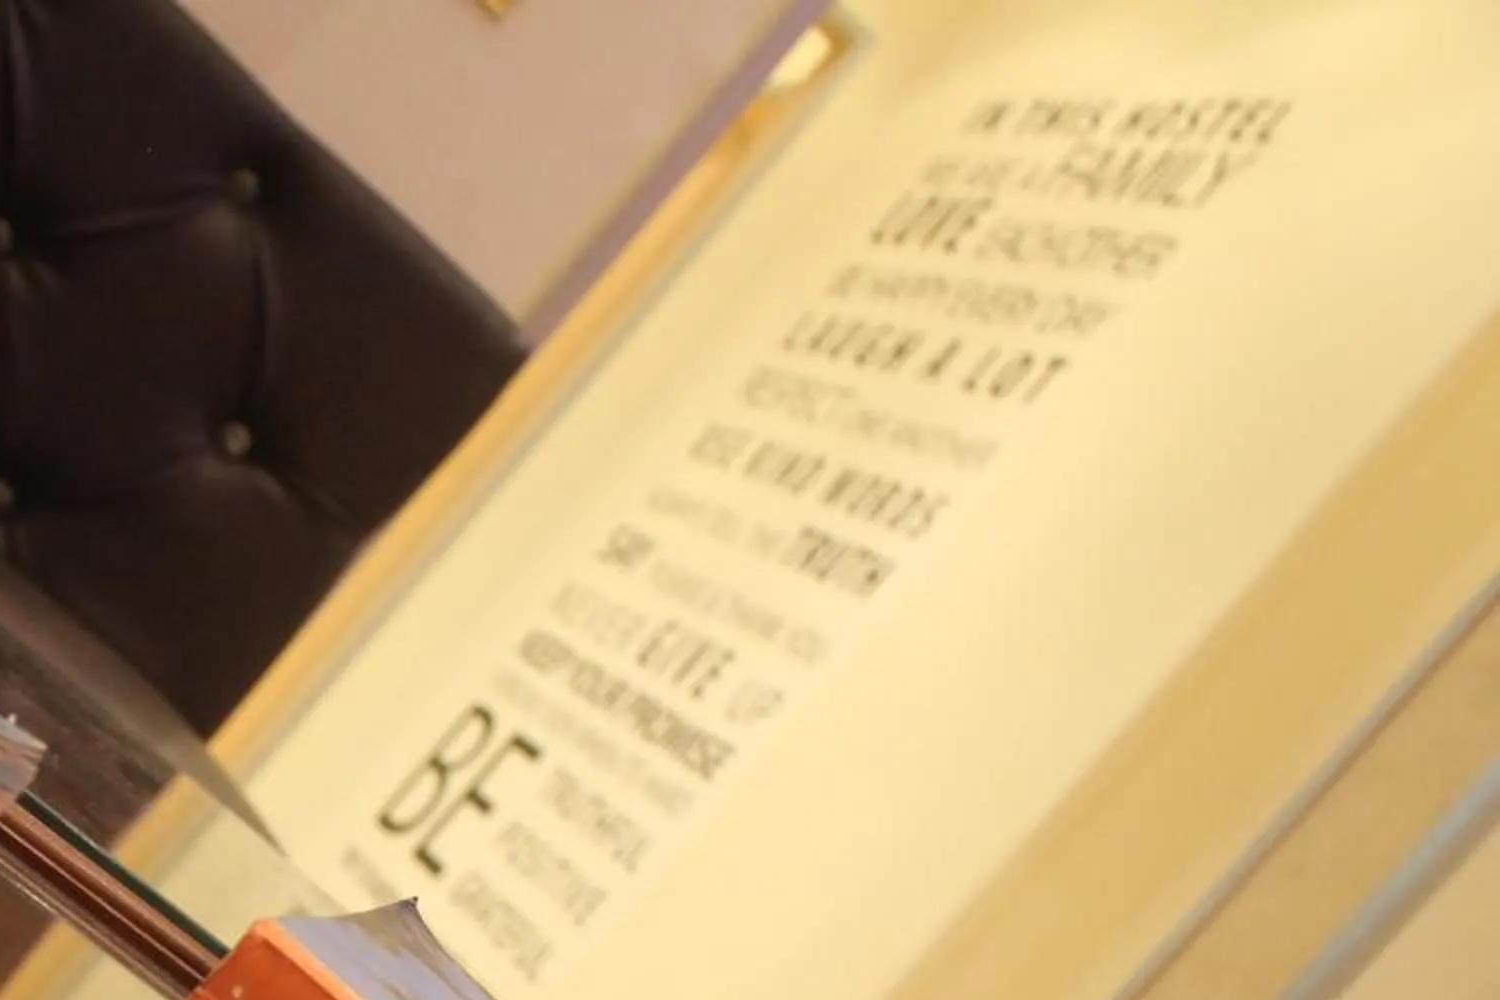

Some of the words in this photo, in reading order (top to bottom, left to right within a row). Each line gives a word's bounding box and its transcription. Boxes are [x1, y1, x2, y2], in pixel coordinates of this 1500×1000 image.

[963, 100, 1013, 134] IN
[1017, 98, 1113, 139] THIS
[1116, 98, 1290, 145] HOSTEL
[1041, 142, 1254, 207] FAMILY
[870, 195, 993, 253] LOVE
[783, 317, 923, 371] LAUGH
[922, 339, 961, 380] A
[962, 349, 1068, 402] LOT
[743, 441, 826, 496] KIND
[822, 469, 947, 537] WORDS
[597, 525, 655, 570] SAY
[783, 527, 893, 596] TRUTH
[636, 620, 735, 697] GIVE
[618, 692, 734, 780] PROMISE
[378, 705, 542, 877] BE
